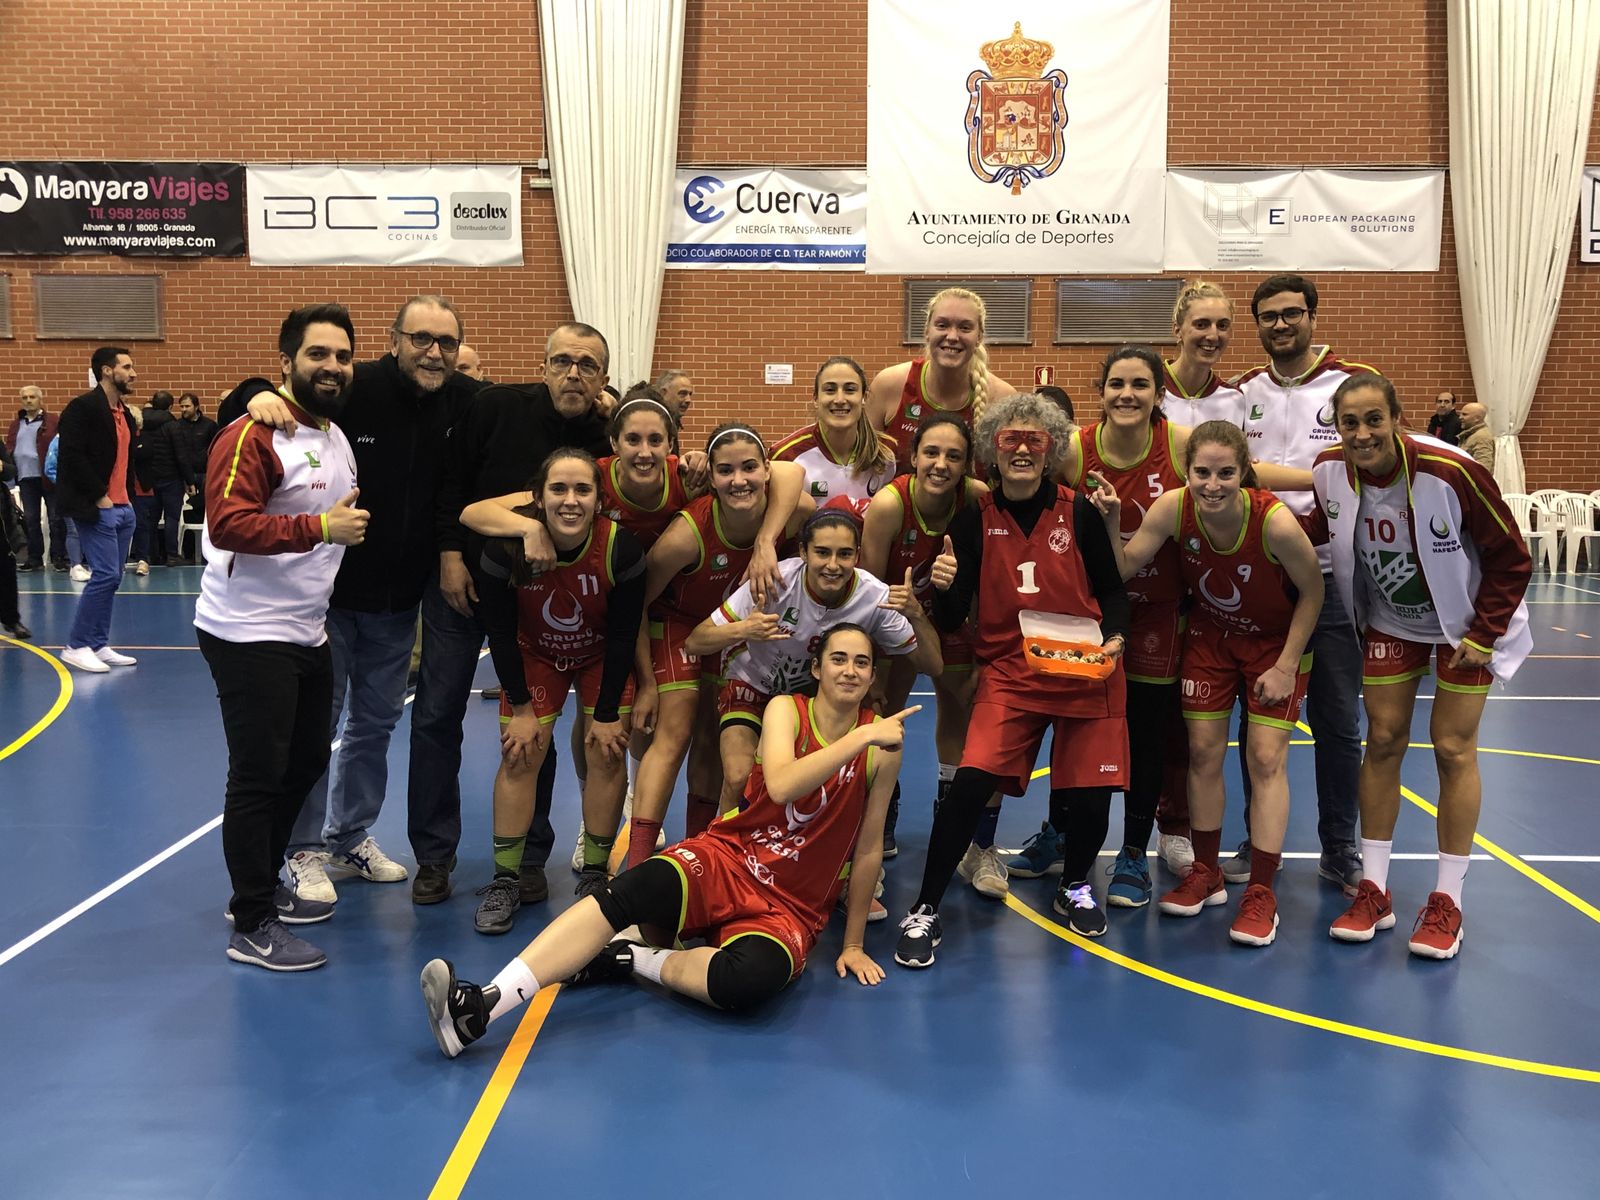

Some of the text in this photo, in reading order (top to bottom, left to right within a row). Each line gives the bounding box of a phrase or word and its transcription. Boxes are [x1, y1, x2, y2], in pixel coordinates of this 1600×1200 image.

[35, 174, 229, 206] ManyaraViajes
[736, 183, 840, 215] Cuerva
[108, 207, 134, 220] 958
[136, 207, 161, 220] 266
[162, 207, 187, 220] 635
[263, 196, 440, 230] BC3
[453, 203, 508, 219] decolux
[1351, 215, 1416, 223] PACKAGING
[82, 223, 113, 232] Alhamar
[117, 223, 126, 232] 18
[136, 223, 158, 232] 18005
[163, 223, 196, 232] Granada
[735, 224, 853, 236] ENERGÍA TRANSPARENTE
[1350, 225, 1415, 233] SOLUTIONS
[63, 234, 216, 249] www.manyaraviajes.com
[388, 233, 439, 241] COCINAS
[922, 231, 1115, 248] Concejalía de Deportes
[666, 248, 688, 258] OCIO
[690, 248, 759, 258] COLABORADOR
[760, 248, 772, 258] DE
[774, 248, 791, 258] C.D.
[794, 248, 817, 258] TEAR
[819, 246, 851, 258] RAMÓN
[853, 248, 860, 258] Y
[1147, 473, 1164, 498] 5
[1364, 517, 1396, 544] 10
[1432, 544, 1462, 553] HAFESA
[1016, 561, 1040, 594] 1
[1237, 564, 1252, 583] 9
[577, 573, 599, 596] 11
[538, 634, 605, 650] HAFESA
[542, 627, 593, 642] GRUPO
[807, 635, 821, 654] 8
